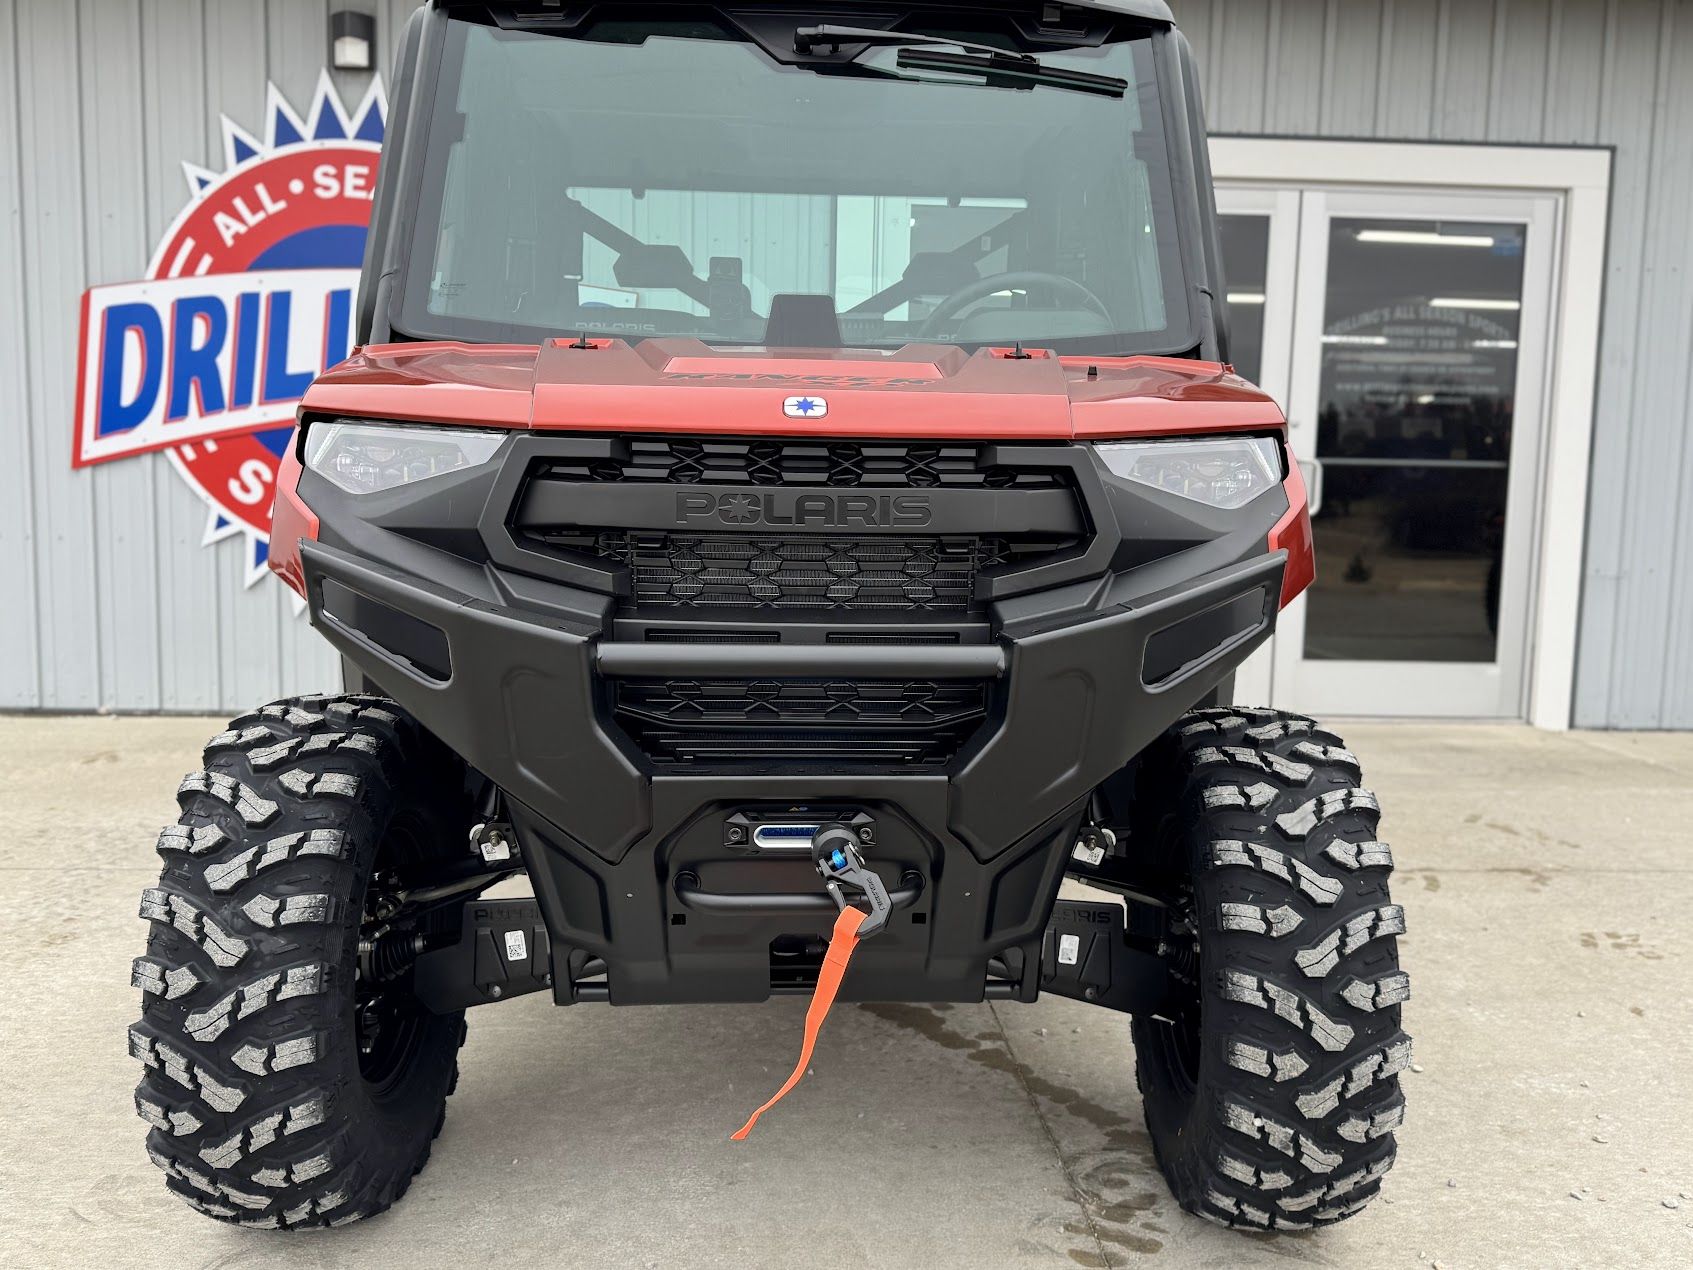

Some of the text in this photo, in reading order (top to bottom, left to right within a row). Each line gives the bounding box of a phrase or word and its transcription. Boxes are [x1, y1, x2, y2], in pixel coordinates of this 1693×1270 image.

[213, 164, 376, 248] ALL SE
[676, 491, 932, 527] POLARIS
